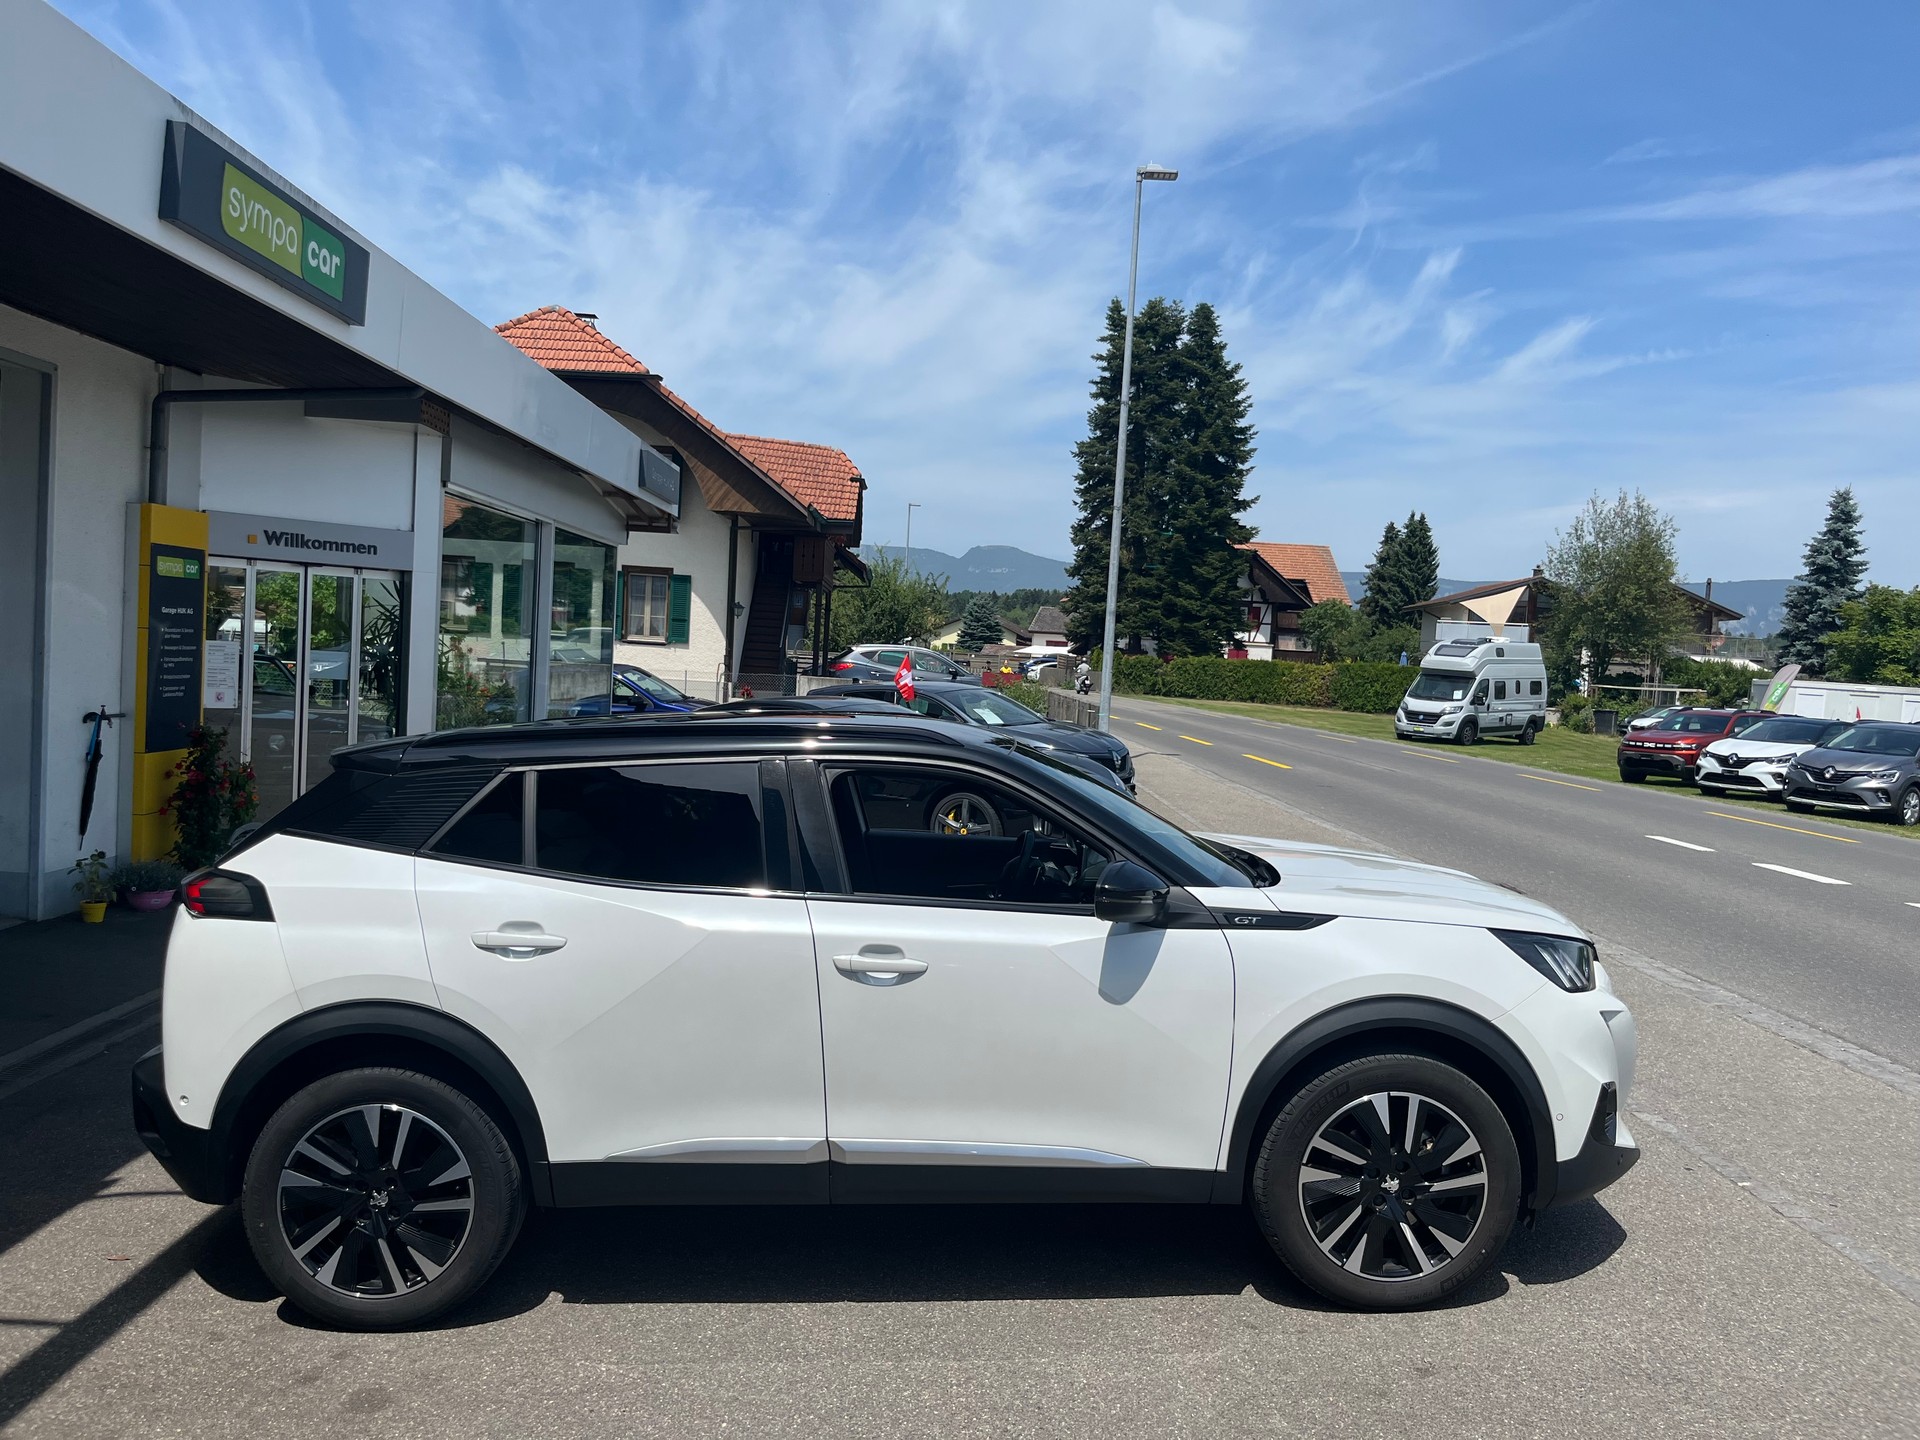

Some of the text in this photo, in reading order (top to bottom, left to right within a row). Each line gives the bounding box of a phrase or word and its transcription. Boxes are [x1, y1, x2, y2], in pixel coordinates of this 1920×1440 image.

[229, 187, 340, 279] sympa car
[263, 529, 378, 555] Willkommen
[159, 561, 199, 575] sympa car
[1234, 916, 1262, 925] GT
